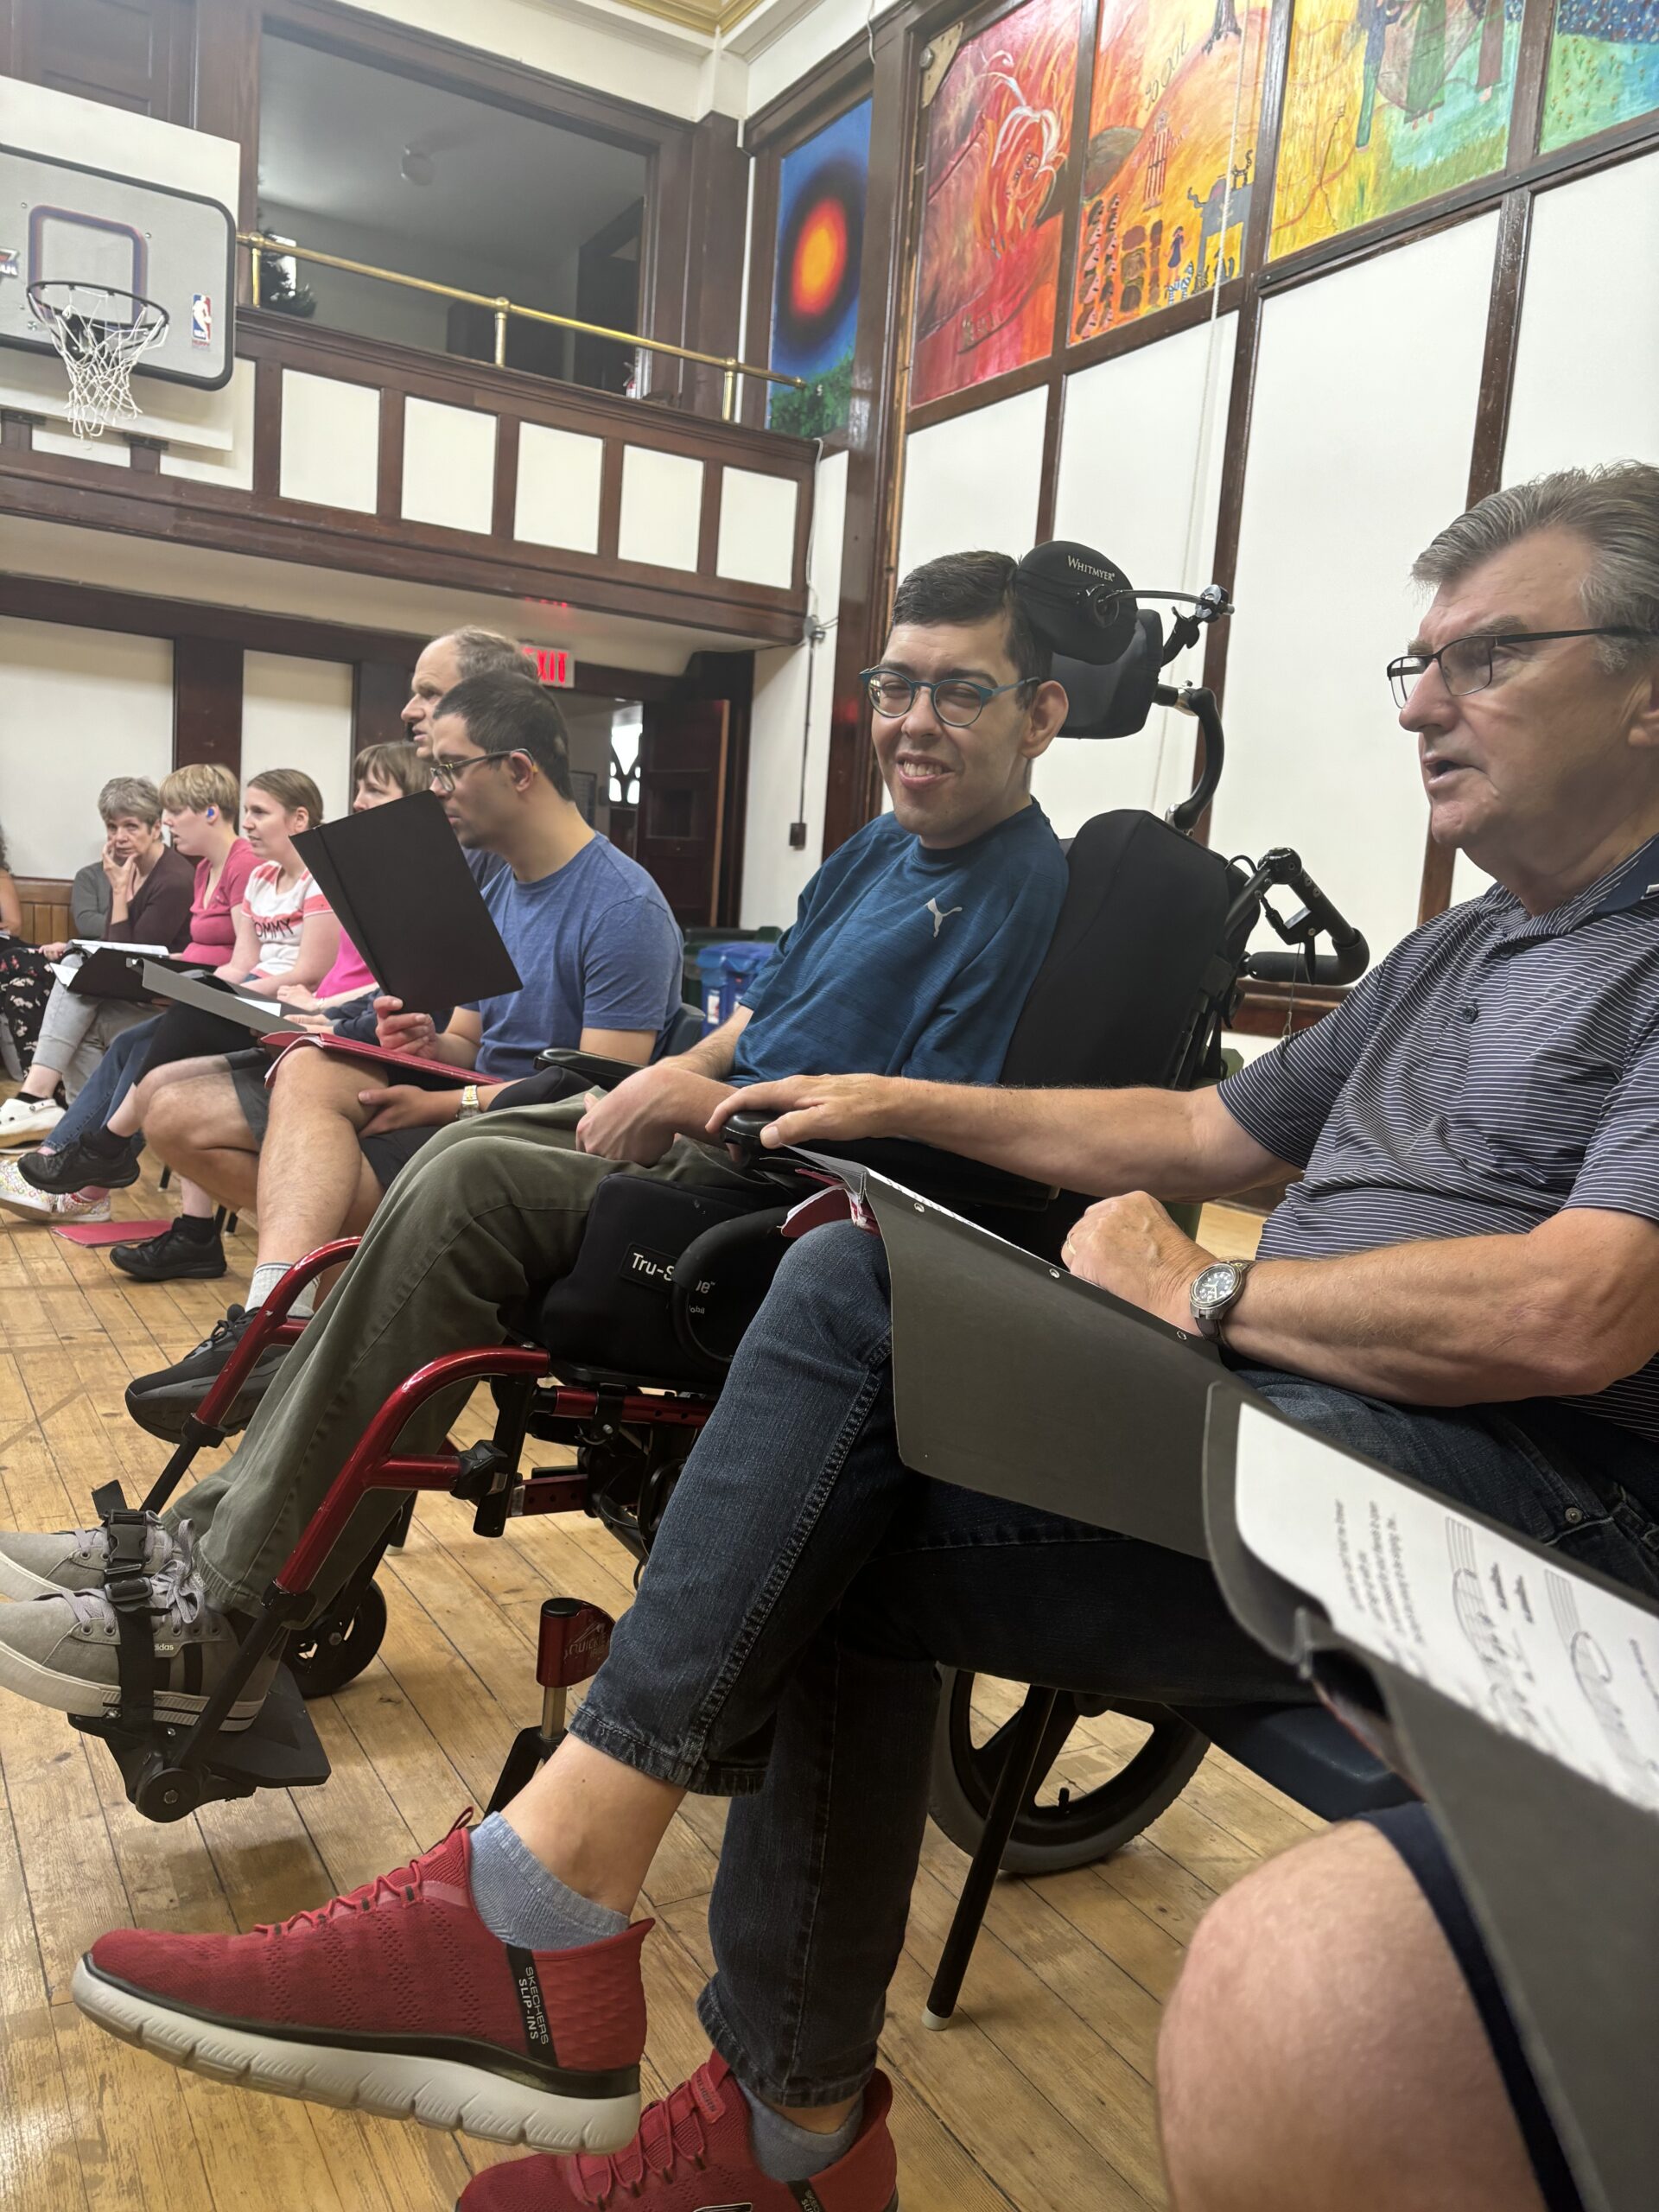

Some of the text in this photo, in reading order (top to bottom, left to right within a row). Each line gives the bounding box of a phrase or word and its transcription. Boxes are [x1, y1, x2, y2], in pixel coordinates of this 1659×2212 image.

[523, 646, 568, 683] XIT
[254, 918, 294, 939] OMMY
[518, 1978, 539, 2040] SLIP-INS
[525, 1966, 550, 2045] SKECHERS
